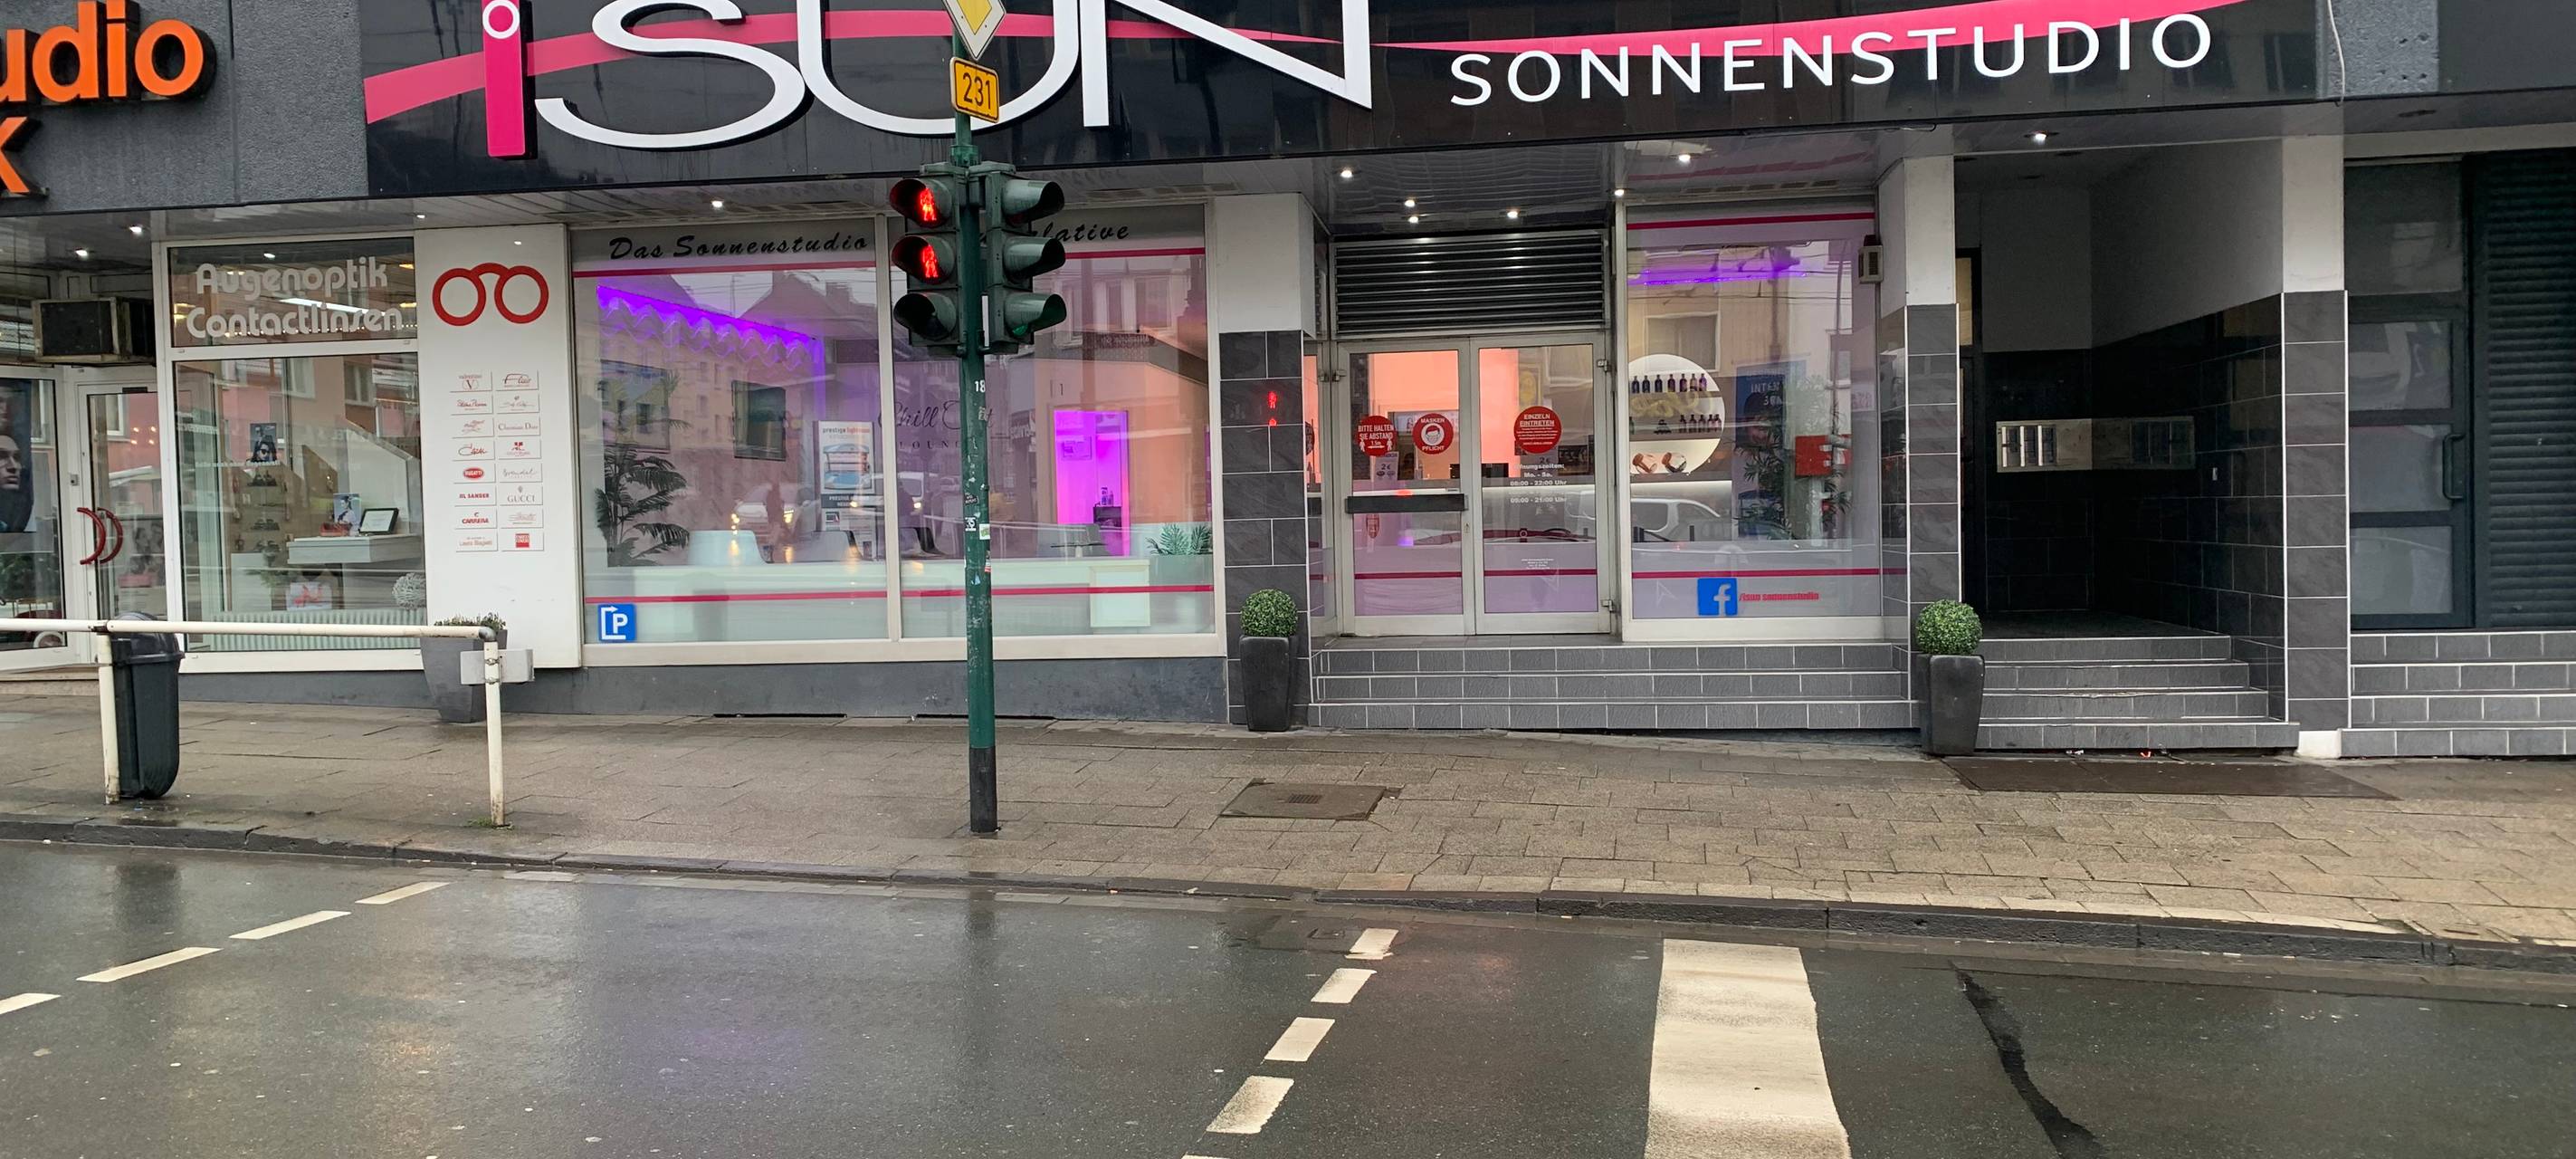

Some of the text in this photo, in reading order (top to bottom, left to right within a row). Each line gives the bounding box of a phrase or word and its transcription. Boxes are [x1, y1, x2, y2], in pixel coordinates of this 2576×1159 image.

[1450, 14, 2212, 106] SONNENSTUDIO
[963, 72, 991, 110] 231
[609, 236, 663, 260] Das
[673, 232, 868, 258] Sonnenstudio
[196, 256, 388, 301] Augenoptik
[186, 302, 403, 339] Contactlinsen
[974, 379, 986, 393] 18
[1369, 432, 1393, 440] ABSTAND
[1374, 424, 1394, 432] HALTEN
[507, 494, 536, 503] GUCCI
[613, 613, 628, 634] P
